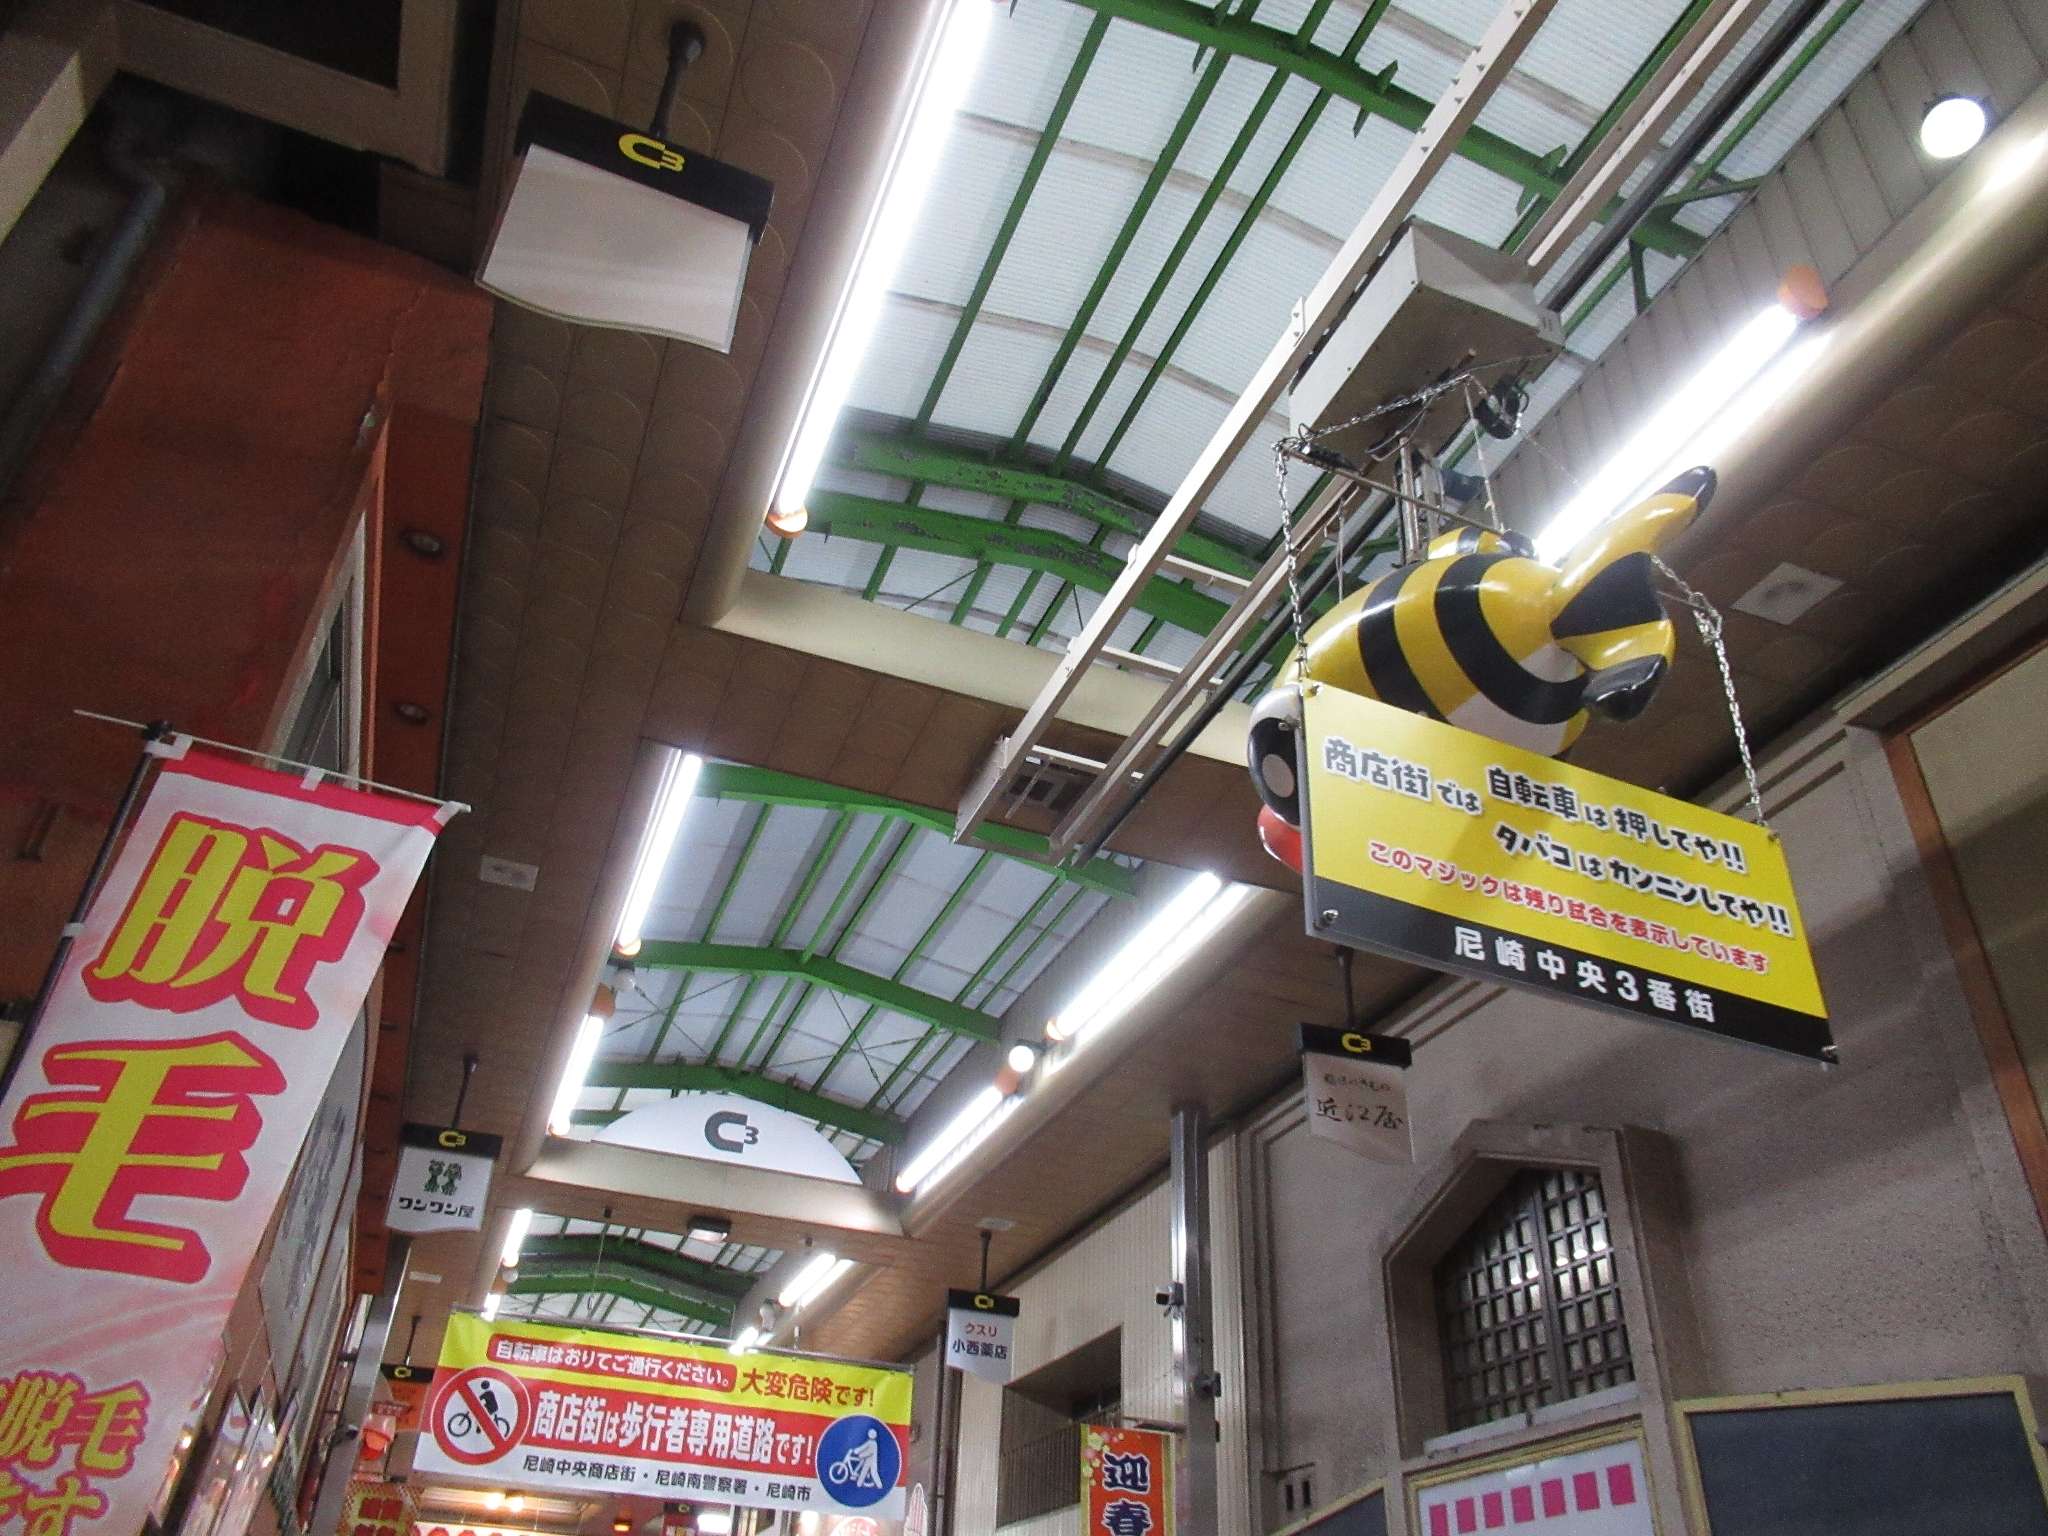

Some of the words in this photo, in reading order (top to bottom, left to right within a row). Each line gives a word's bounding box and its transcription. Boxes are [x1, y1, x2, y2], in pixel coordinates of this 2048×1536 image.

[1488, 766, 1747, 873] 自転車は押してや!!
[1368, 842, 1769, 974] このマジックは残り試合を表示しています
[1494, 824, 1792, 936] タバコはカンニンしてや!!
[1454, 926, 1716, 1023] 尼崎中央3番街
[0, 811, 379, 1283] 脱毛
[704, 1111, 760, 1154] C3
[398, 1197, 474, 1218] ワンワン屋
[496, 1338, 732, 1387] 自転車はおりてご通行ください。
[740, 1370, 876, 1408] 大変危険です!
[952, 1339, 1008, 1360] 小西薬店
[966, 1323, 997, 1337] クスリ
[0, 1370, 151, 1478] 脱毛
[531, 1390, 813, 1467] 商店街は歩行者専用道路です!
